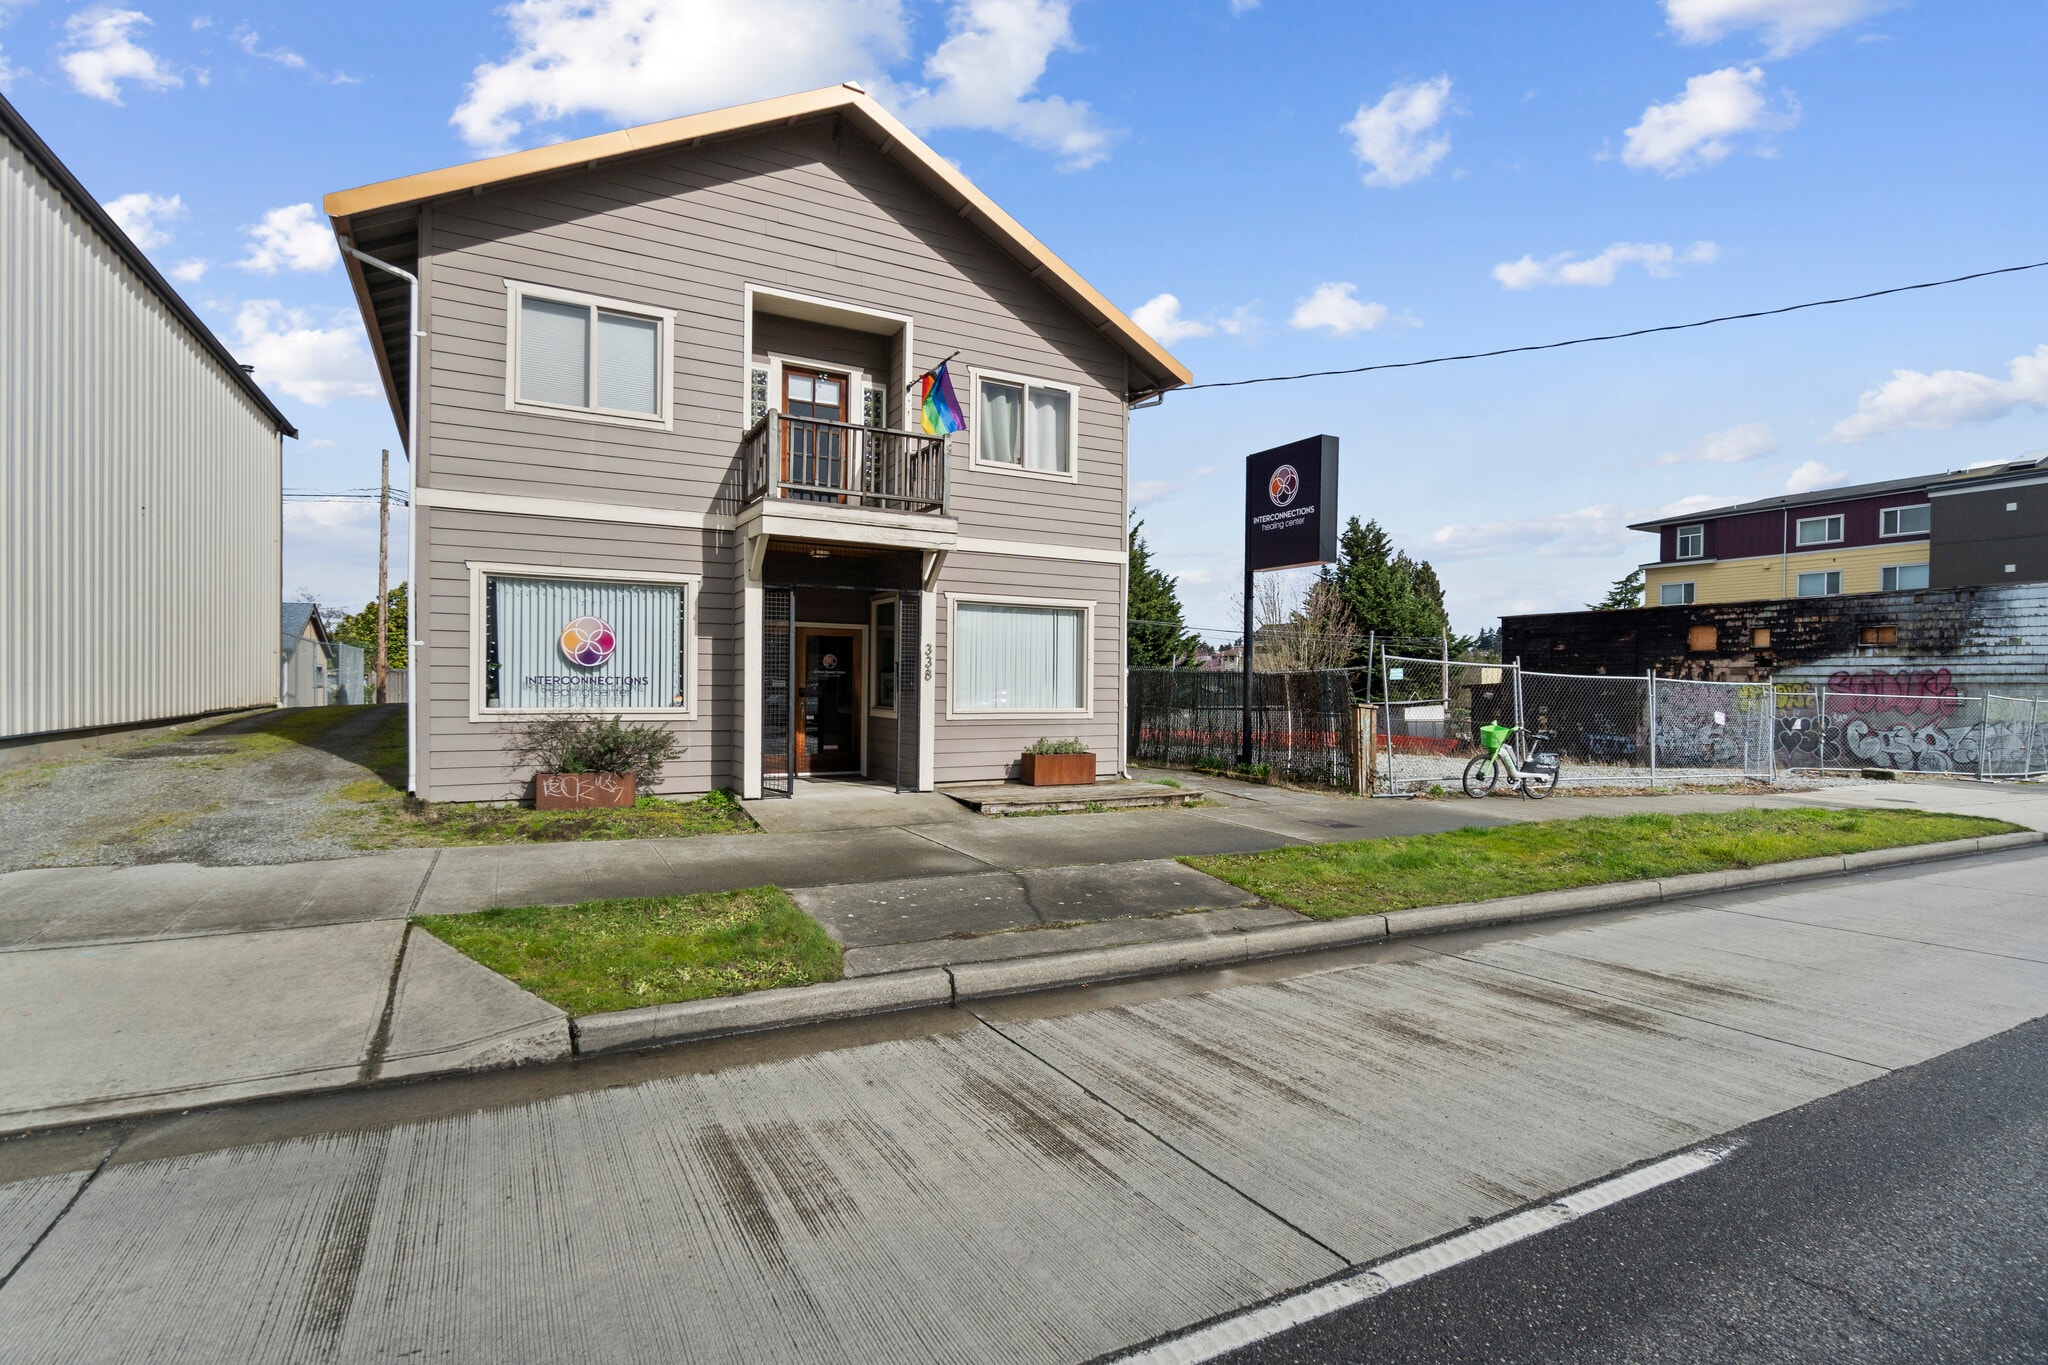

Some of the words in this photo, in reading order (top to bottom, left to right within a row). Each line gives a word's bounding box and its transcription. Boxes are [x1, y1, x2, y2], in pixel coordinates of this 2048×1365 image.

[1253, 505, 1315, 524] INTERCONNECTIONS
[1262, 521, 1284, 531] healing
[1285, 517, 1305, 527] center
[924, 643, 933, 681] 338
[525, 675, 649, 686] INTERCONNECTIONS
